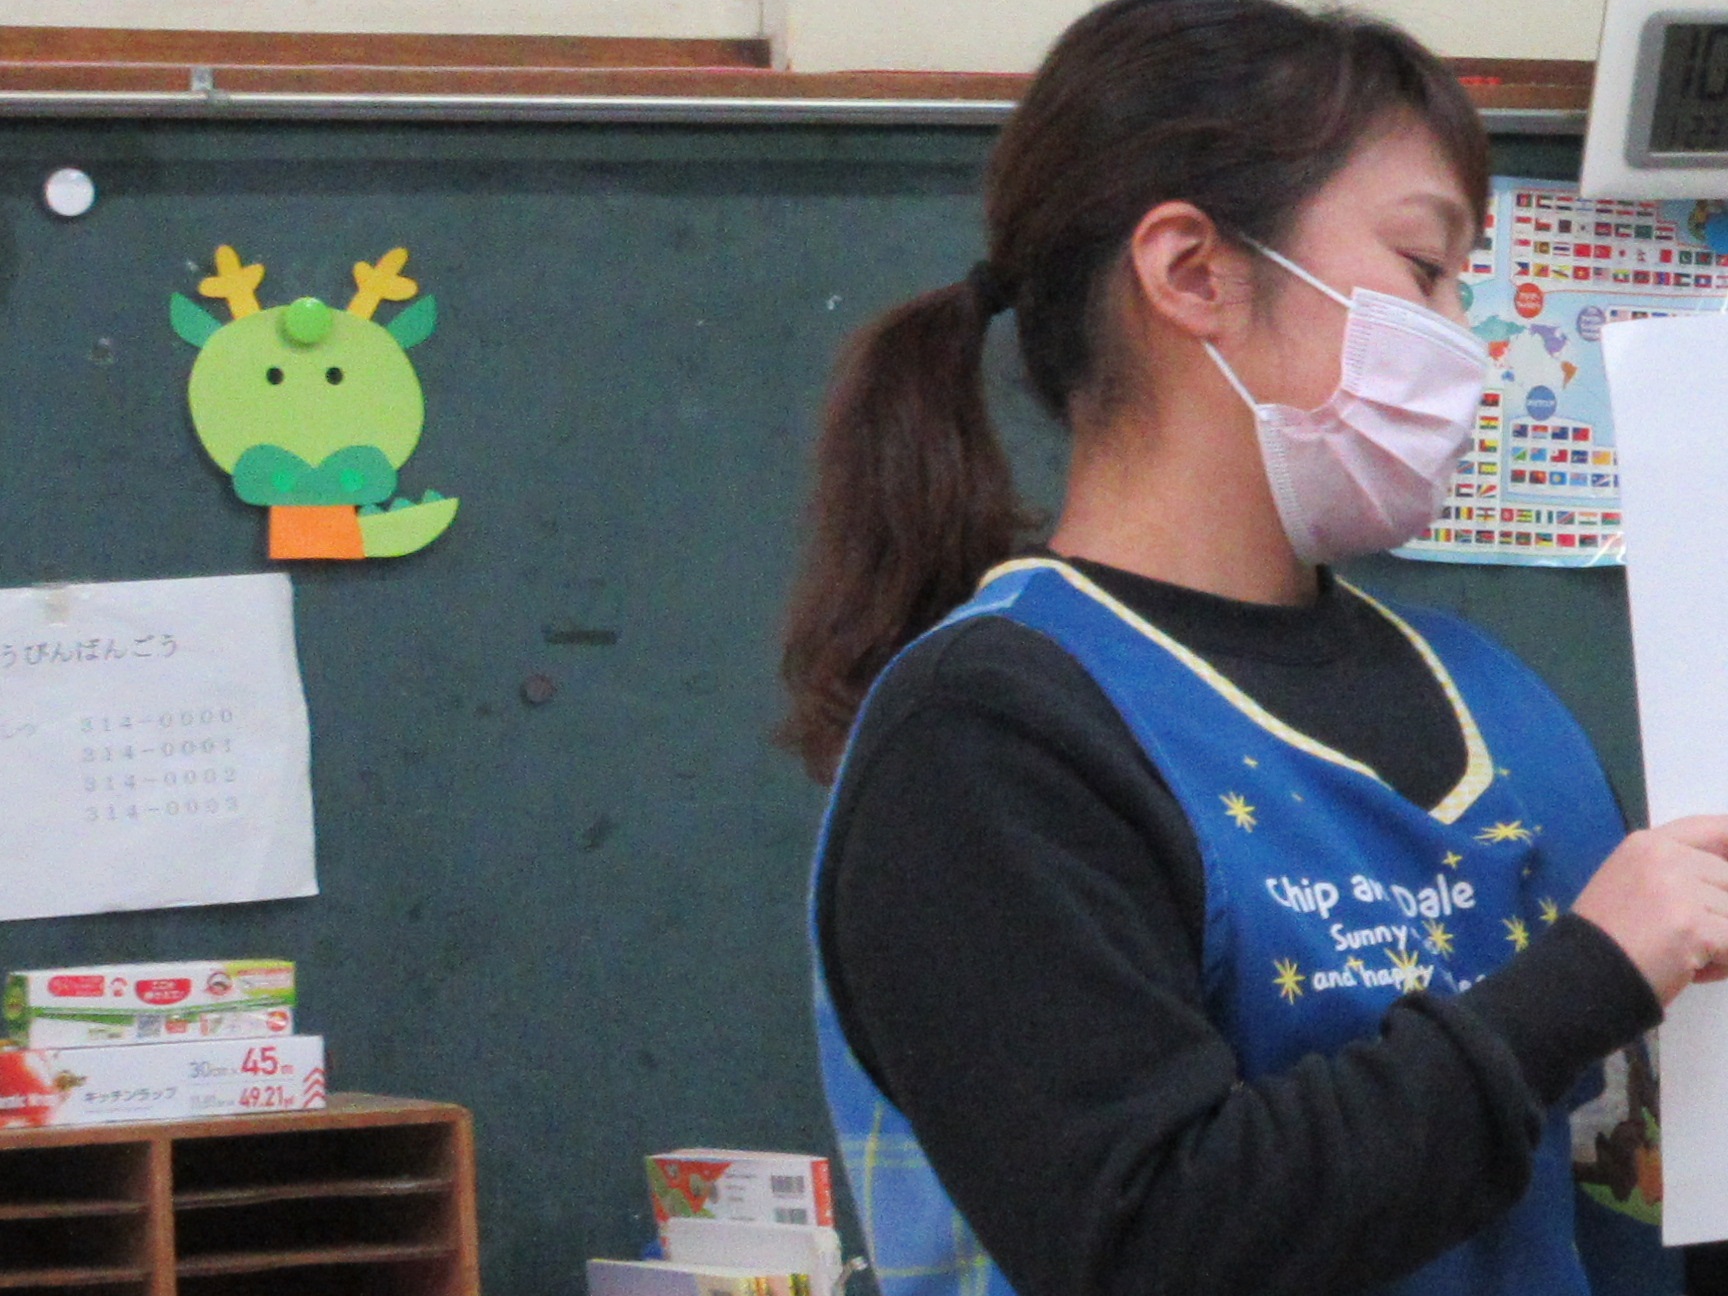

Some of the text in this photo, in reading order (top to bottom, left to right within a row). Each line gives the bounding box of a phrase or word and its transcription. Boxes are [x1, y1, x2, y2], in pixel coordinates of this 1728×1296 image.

[1265, 875, 1340, 919] Chip
[1391, 873, 1476, 918] Dale
[1329, 923, 1409, 953] Sunny
[1312, 963, 1357, 992] and
[85, 1085, 178, 1103] キッチンラップ
